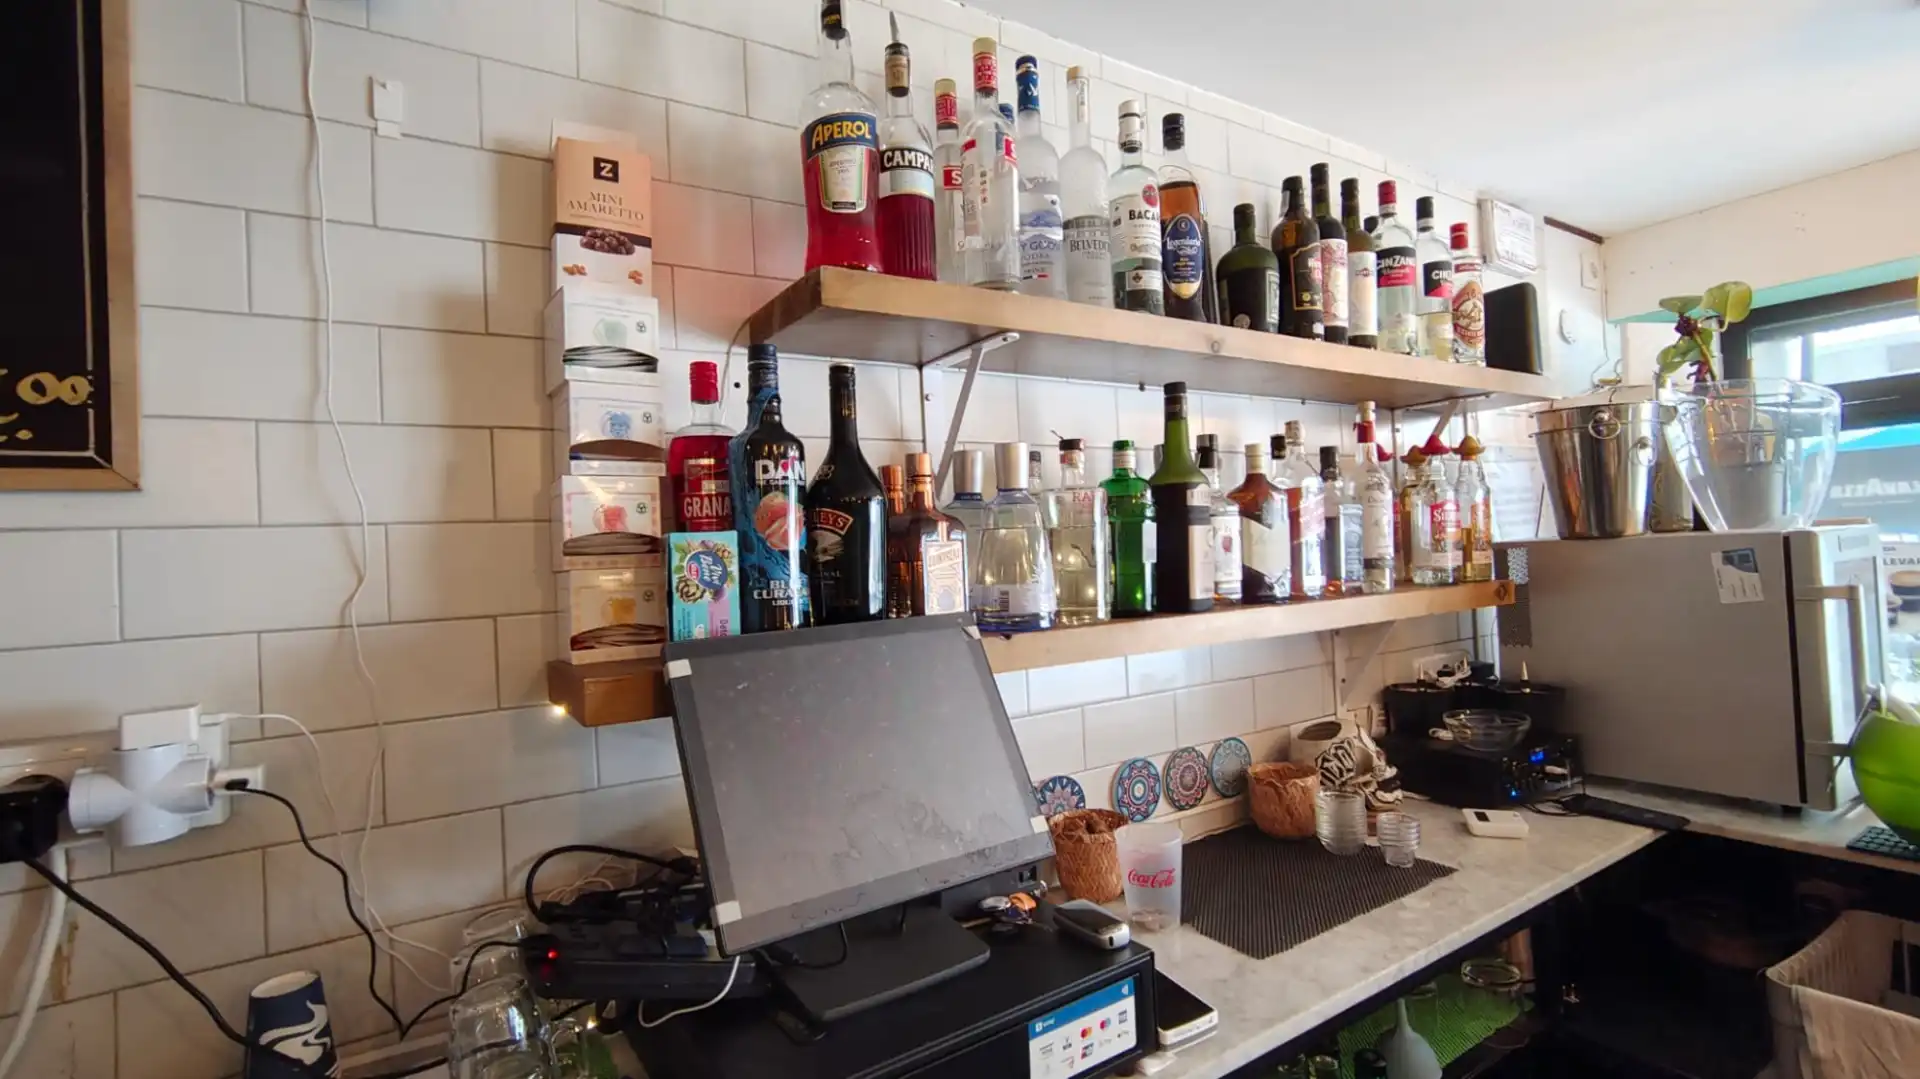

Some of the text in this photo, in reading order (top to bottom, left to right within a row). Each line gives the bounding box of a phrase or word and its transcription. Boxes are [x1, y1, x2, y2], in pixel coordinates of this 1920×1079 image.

[812, 121, 872, 150] APEROL
[599, 162, 613, 177] Z
[589, 191, 623, 206] MINI
[567, 200, 644, 221] AMARETTO
